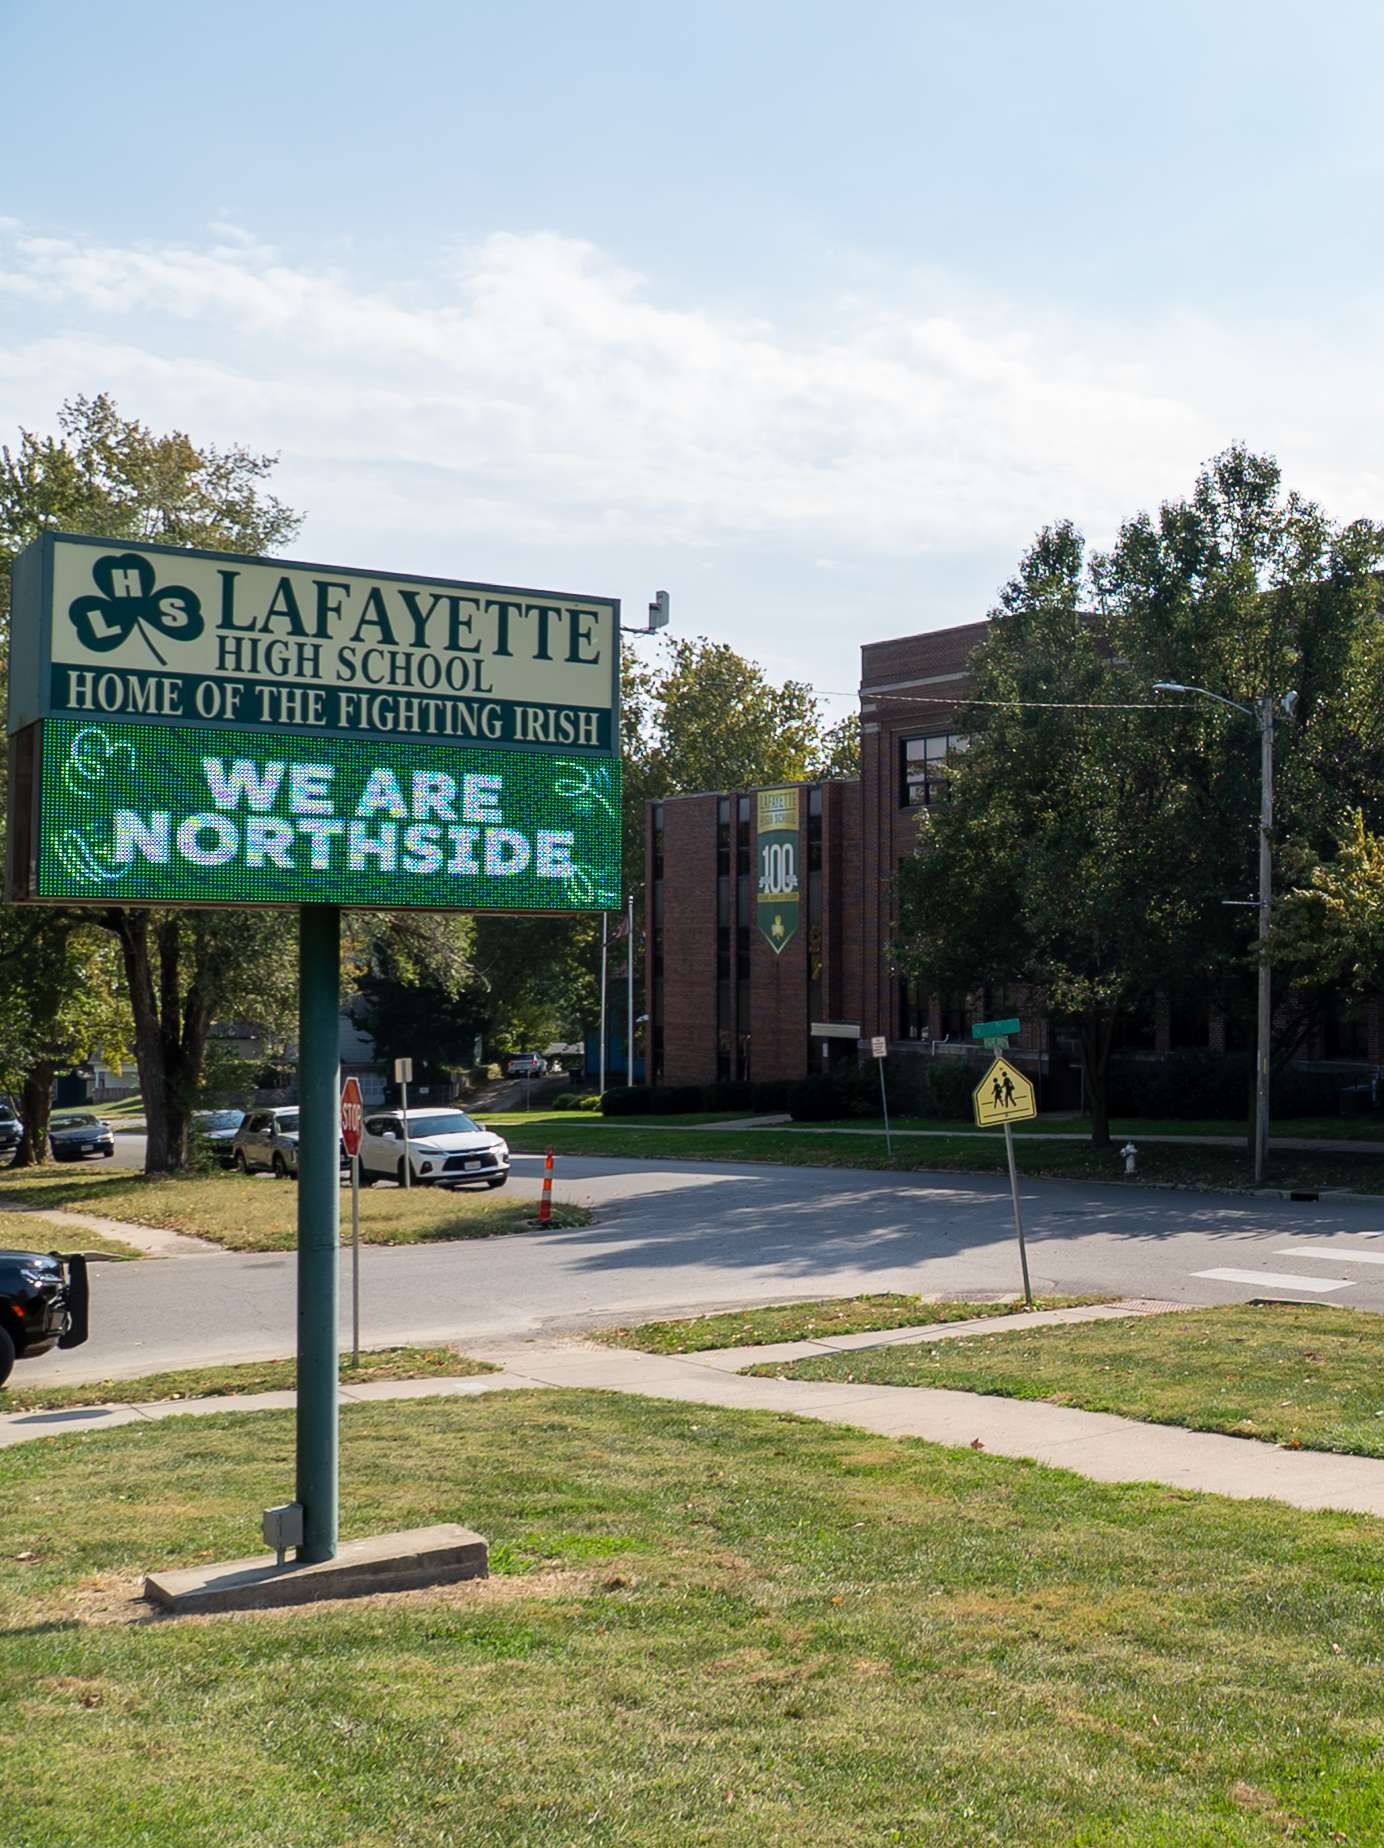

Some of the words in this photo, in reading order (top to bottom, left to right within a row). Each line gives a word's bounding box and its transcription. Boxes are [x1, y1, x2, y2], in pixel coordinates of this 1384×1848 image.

[216, 569, 600, 665] LAFAYETTE
[215, 634, 323, 679] HIGH
[336, 645, 493, 693] SCHOOL
[66, 670, 183, 715] HOME
[195, 680, 244, 719] OF
[255, 685, 327, 726] THE
[337, 692, 503, 738] FIGHTING
[513, 706, 600, 745] IRISH
[201, 757, 335, 814] WE
[354, 767, 503, 823] ARE
[113, 808, 575, 877] NORTHSIDE
[762, 843, 794, 893] 100
[342, 1102, 361, 1132] STOP
